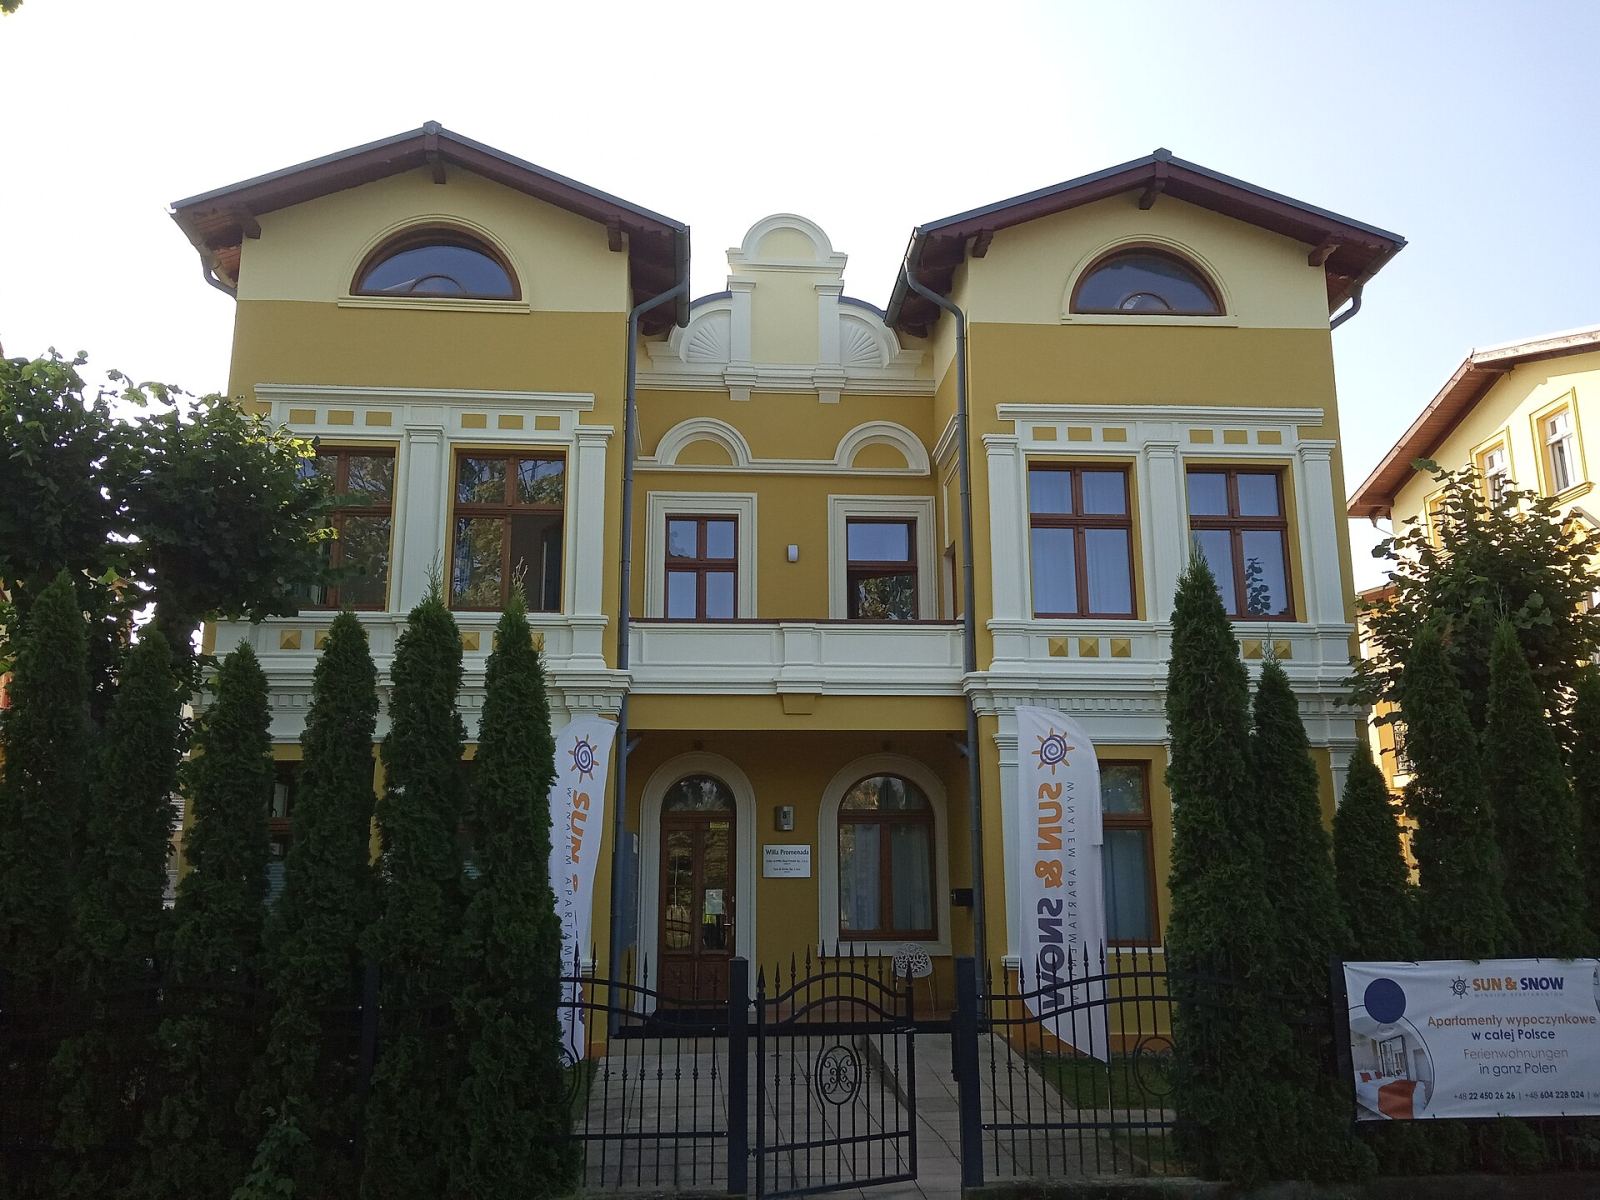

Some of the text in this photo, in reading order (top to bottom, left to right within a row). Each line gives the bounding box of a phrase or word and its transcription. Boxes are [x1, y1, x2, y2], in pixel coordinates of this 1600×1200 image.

[570, 789, 590, 864] SUN
[1472, 976, 1565, 991] SUN & SNOW
[1428, 1013, 1597, 1029] Apartamenty wypoczynkowe
[1472, 1028, 1556, 1043] w całej Polsce
[1464, 1048, 1569, 1061] Ferienwohnungen
[1479, 1062, 1558, 1077] in ganz Polen
[1469, 1092, 1478, 1100] 22
[1480, 1091, 1493, 1100] 450
